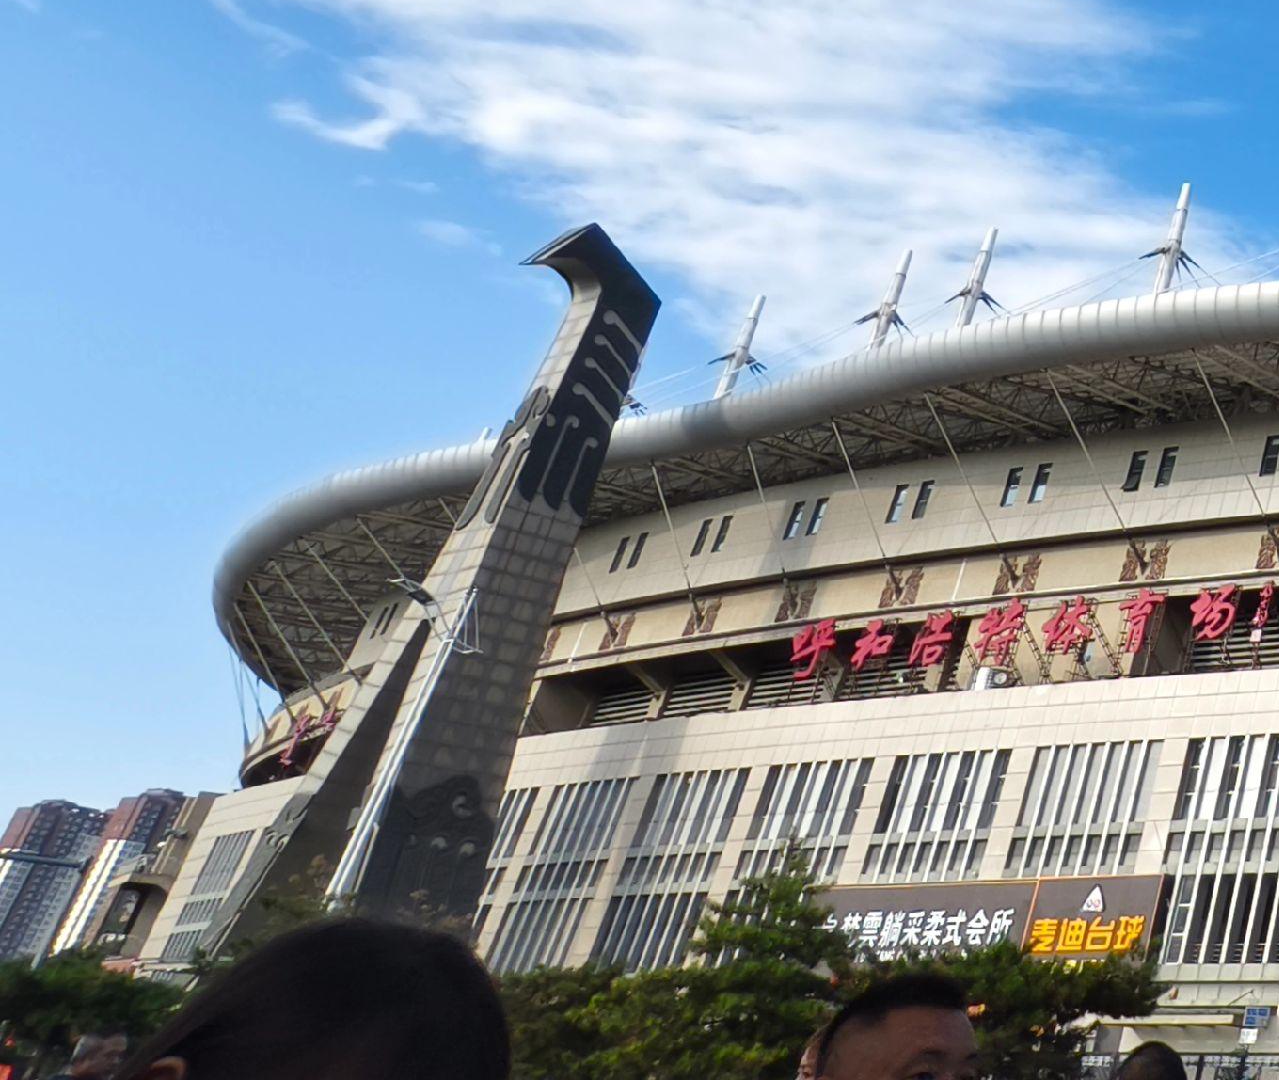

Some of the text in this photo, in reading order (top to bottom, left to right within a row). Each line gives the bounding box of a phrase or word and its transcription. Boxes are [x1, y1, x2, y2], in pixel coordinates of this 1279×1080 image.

[792, 584, 1237, 678] 呼和浩特体育场
[1029, 915, 1145, 953] 麦迪台球
